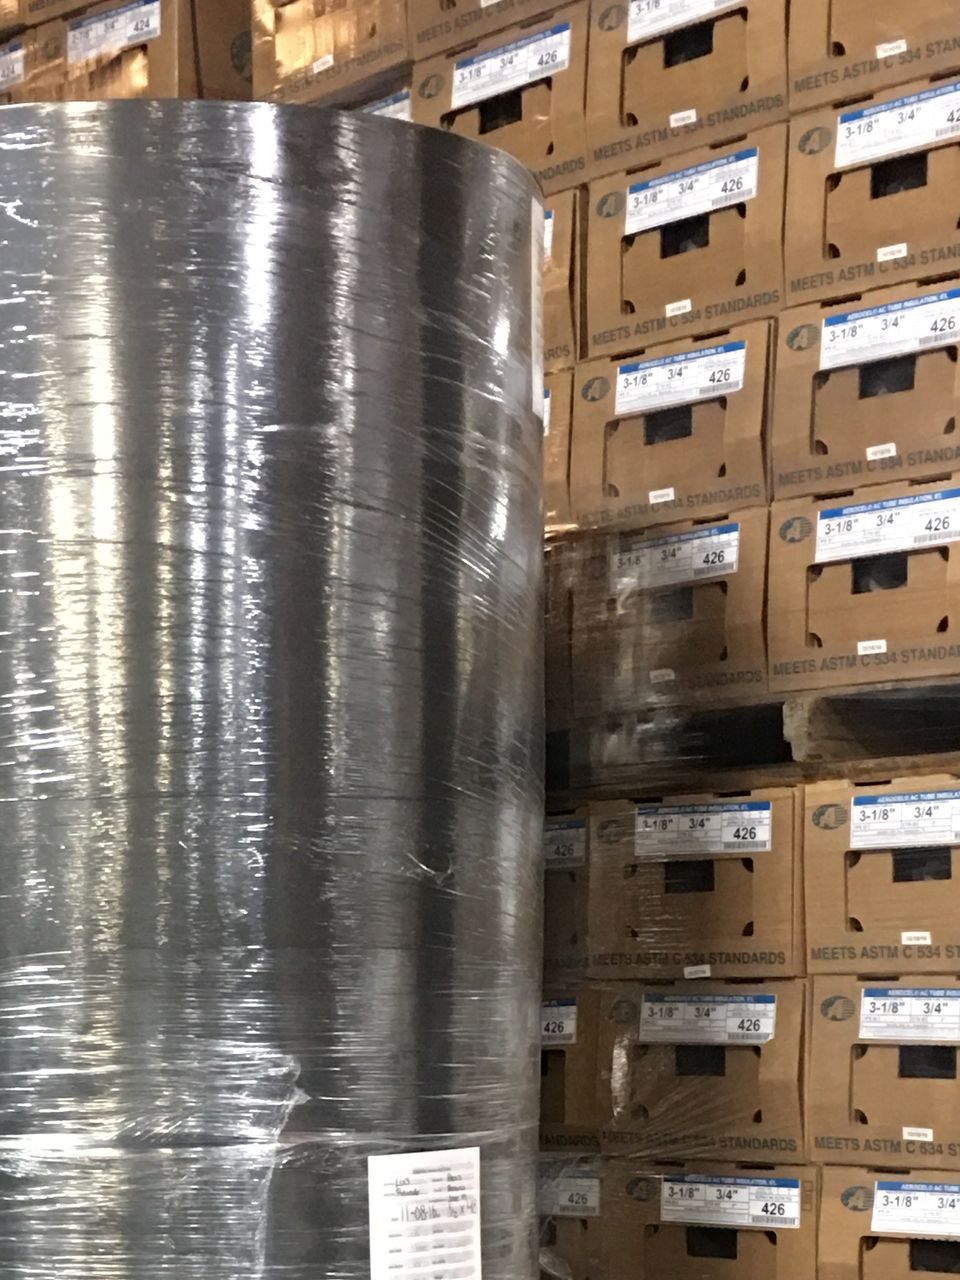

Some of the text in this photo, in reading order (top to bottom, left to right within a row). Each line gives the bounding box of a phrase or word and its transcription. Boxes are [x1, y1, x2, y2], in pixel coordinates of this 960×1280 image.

[636, 0, 660, 17] 3-1/8
[537, 50, 558, 66] 426
[794, 69, 839, 92] MEETS
[843, 58, 880, 80] ASTM
[884, 57, 894, 69] C
[897, 107, 922, 125] 3/4"
[946, 109, 960, 123] 42
[593, 139, 633, 161] MEETS
[636, 127, 669, 147] ASTM
[706, 94, 784, 127] STANDARDS
[845, 118, 879, 139] 3-1/8"
[678, 178, 700, 195] 3/4"
[721, 177, 743, 194] 426
[633, 189, 663, 209] 3-1/8"
[791, 255, 916, 293] MEETS ASTM C 534
[592, 326, 630, 346] MEETS
[634, 316, 667, 336] ASTM
[669, 315, 679, 328] C
[704, 289, 780, 317] STANDARDS
[881, 314, 905, 331] 3/4"
[930, 316, 956, 333] 426
[829, 324, 863, 342] 3-1/8"
[667, 366, 688, 380] 3/4"
[709, 368, 730, 384] 426
[623, 373, 653, 389] 3-1/8"
[778, 468, 823, 486] MEETS
[827, 461, 863, 479] ASTM
[867, 459, 877, 472] C
[908, 447, 960, 467] STANDA
[687, 483, 760, 508] STANDARDS
[876, 511, 900, 526] 3/4"
[925, 516, 950, 532] 426
[825, 518, 859, 535] 3-1/8"
[703, 550, 725, 565] 426
[773, 659, 817, 676] MEETS
[820, 654, 857, 671] ASTM
[861, 653, 870, 666] C
[873, 651, 897, 665] 534
[900, 645, 960, 664] STANDA
[859, 808, 895, 822] 3-1/8"
[914, 805, 939, 818] 3/4"
[688, 817, 710, 829] 3/4"
[733, 827, 756, 840] 426
[554, 845, 574, 857] 426
[708, 951, 786, 966] STANDARDS
[811, 946, 857, 960] MEETS
[861, 946, 899, 960] ASTM
[903, 945, 912, 959] C
[917, 945, 940, 958] 534
[648, 1007, 679, 1018] 3-1/8"
[694, 1007, 716, 1018] 3/4"
[869, 1002, 905, 1014] 3-1/8"
[923, 1002, 948, 1014] 3/4"
[544, 1021, 564, 1033] 426
[738, 1019, 761, 1031] 426
[721, 1138, 797, 1152] STANDARDS
[814, 1136, 859, 1151] MEETS
[864, 1138, 901, 1153] ASTM
[905, 1140, 915, 1154] C
[919, 1141, 944, 1156] 534
[567, 1193, 588, 1205] 426
[668, 1186, 700, 1199] 3-1/8"
[716, 1189, 738, 1200] 3/4"
[883, 1195, 919, 1208] 3-1/8"
[761, 1203, 785, 1216] 426
